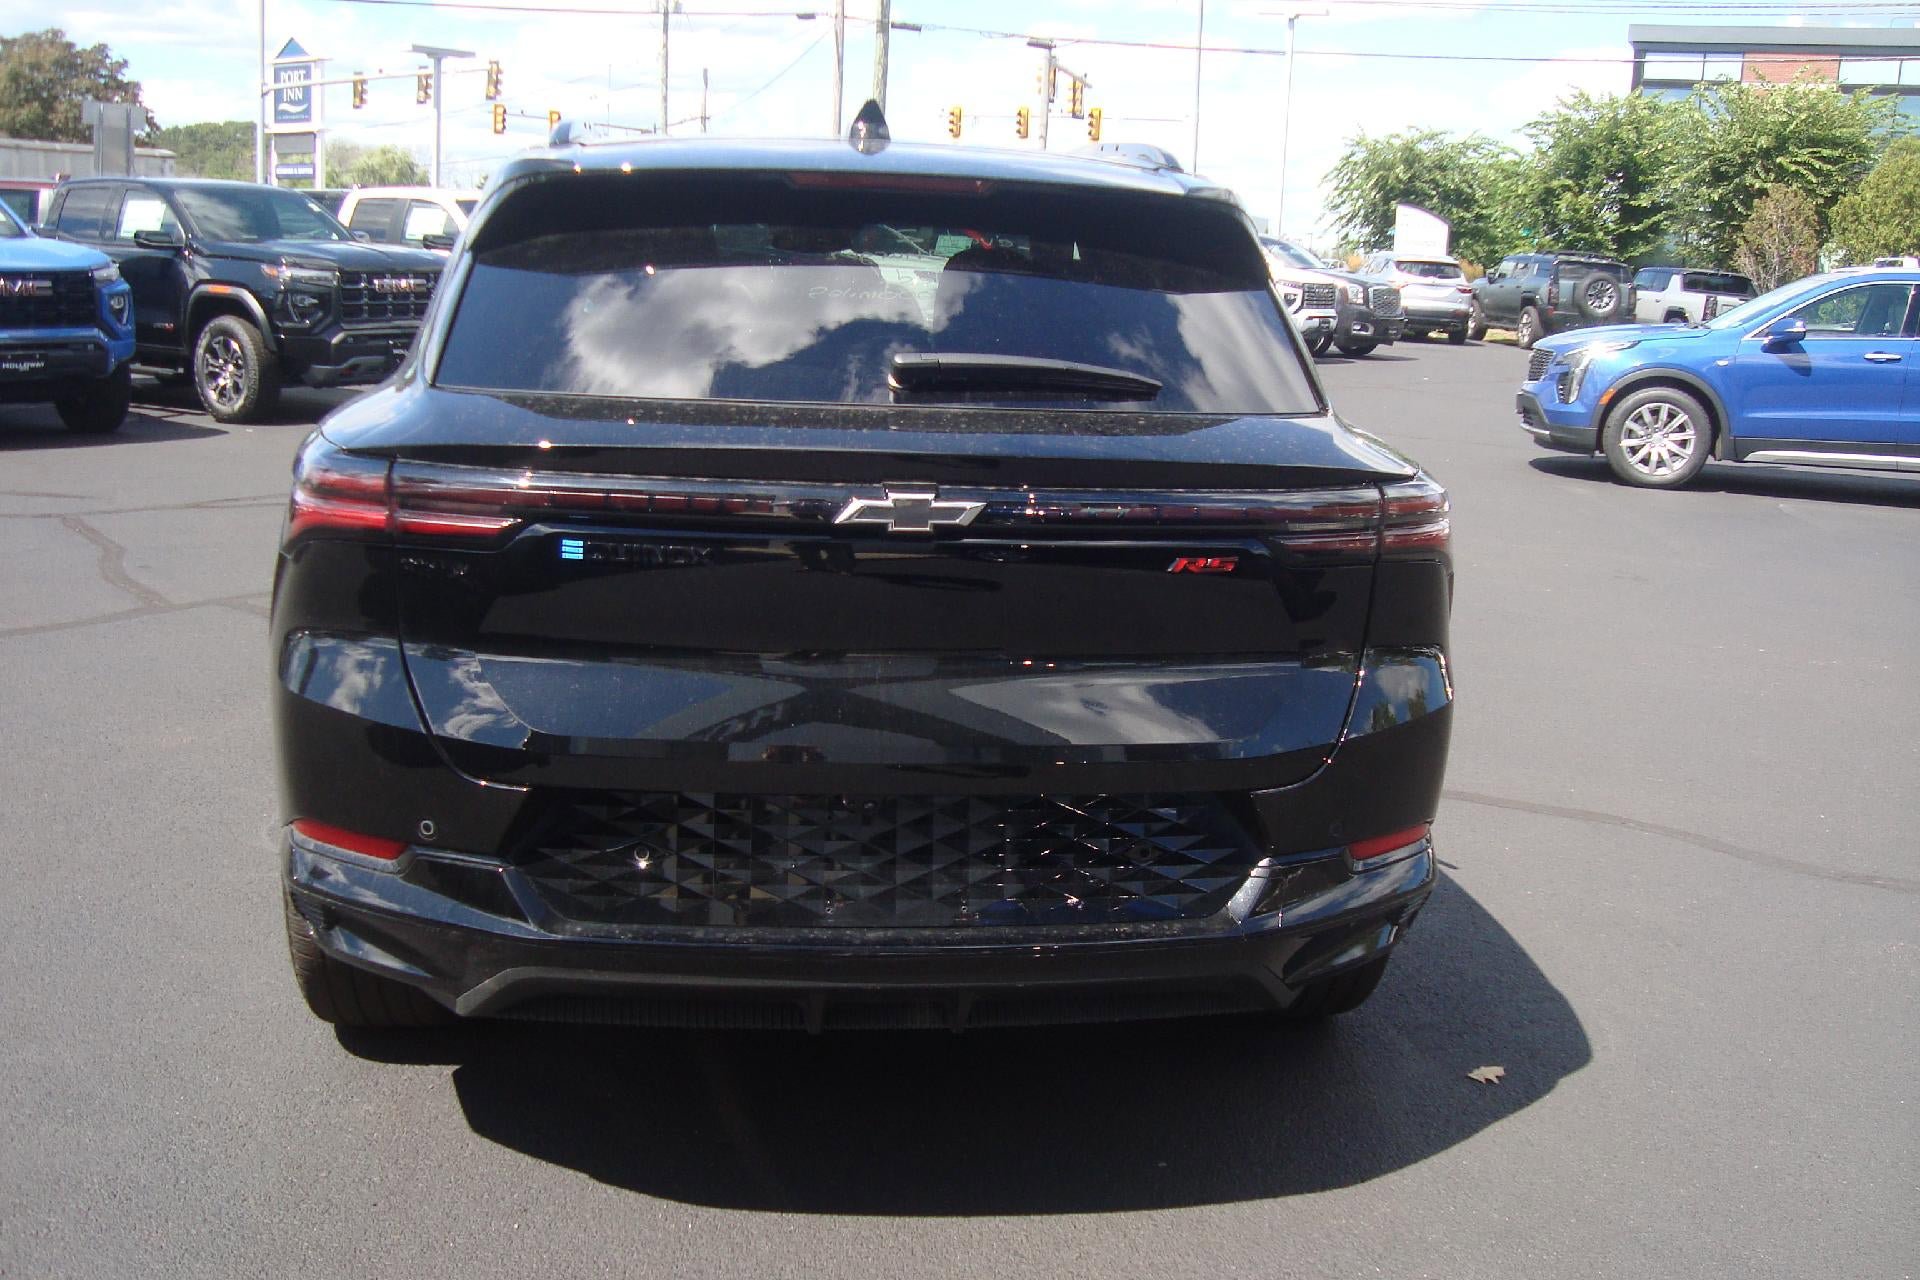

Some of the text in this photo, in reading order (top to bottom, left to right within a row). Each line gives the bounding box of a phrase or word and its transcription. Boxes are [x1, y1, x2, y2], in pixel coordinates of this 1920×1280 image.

[281, 70, 306, 83] PORT
[283, 87, 303, 101] INN
[0, 278, 52, 296] MC
[373, 278, 427, 294] GMC
[2, 361, 45, 370] HOLLOWAY
[1167, 557, 1240, 573] RS
